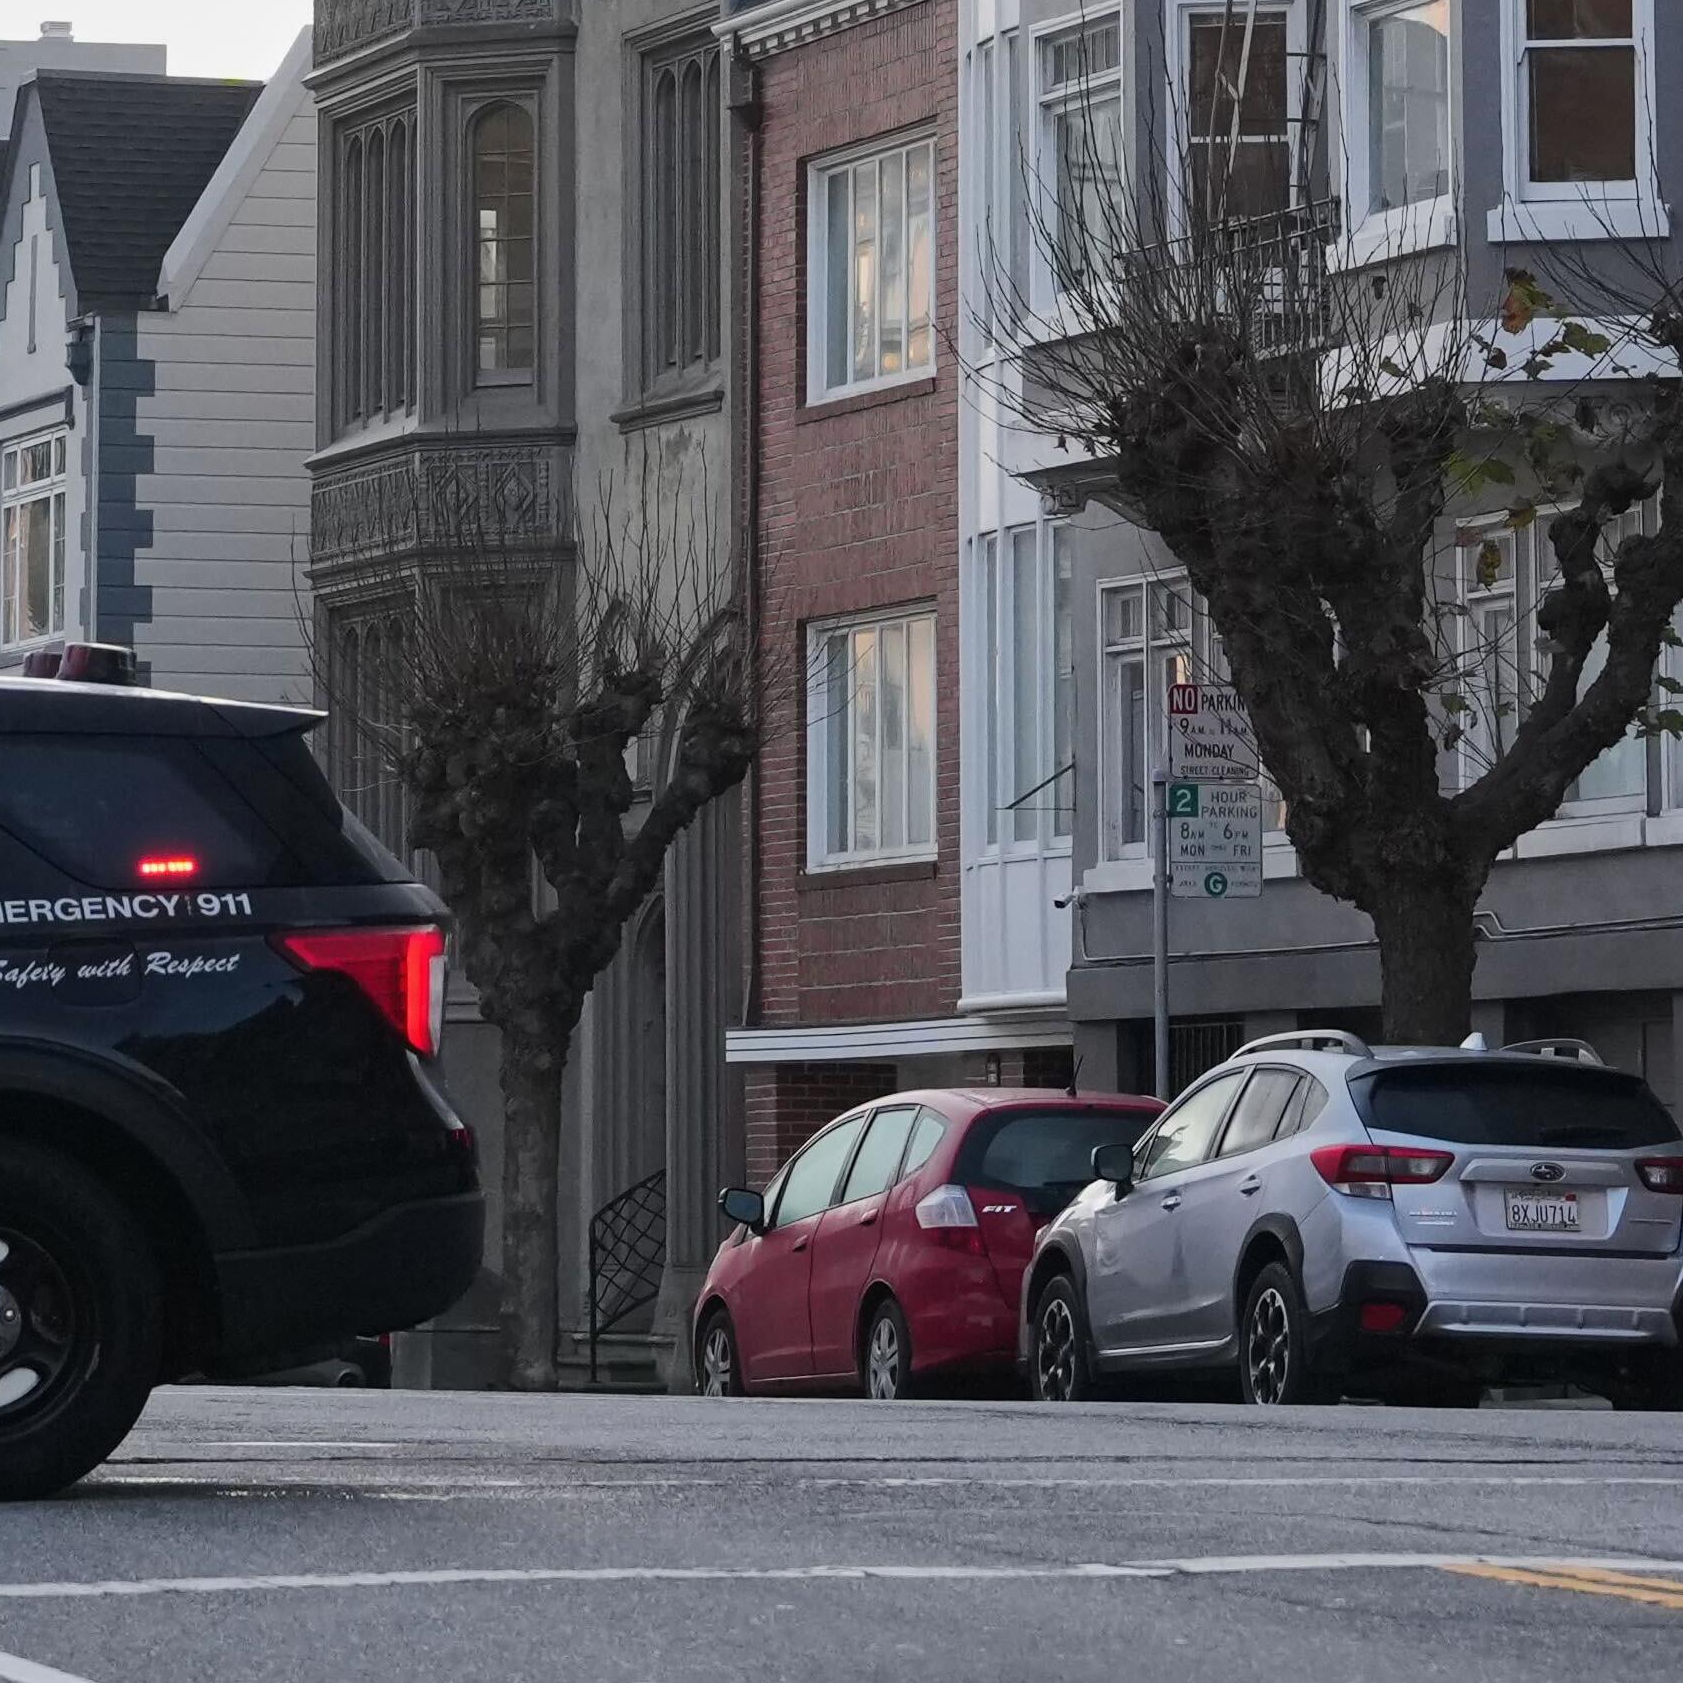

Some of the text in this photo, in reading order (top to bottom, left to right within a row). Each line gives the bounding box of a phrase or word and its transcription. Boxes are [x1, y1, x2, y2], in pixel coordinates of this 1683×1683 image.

[1173, 687, 1246, 712] NO PARKIN
[1184, 743, 1234, 758] MONDAY
[1180, 765, 1208, 776] STREET
[1176, 789, 1247, 812] 2 HOUR
[1201, 806, 1258, 819] PARKING
[1180, 844, 1205, 857] MON
[1233, 844, 1252, 857] FRI
[1209, 875, 1223, 894] G
[197, 893, 253, 917] 911
[77, 953, 134, 979] with
[144, 951, 241, 977] Respect
[981, 1205, 1018, 1213] FIT
[1511, 1204, 1577, 1223] 8XJU714
